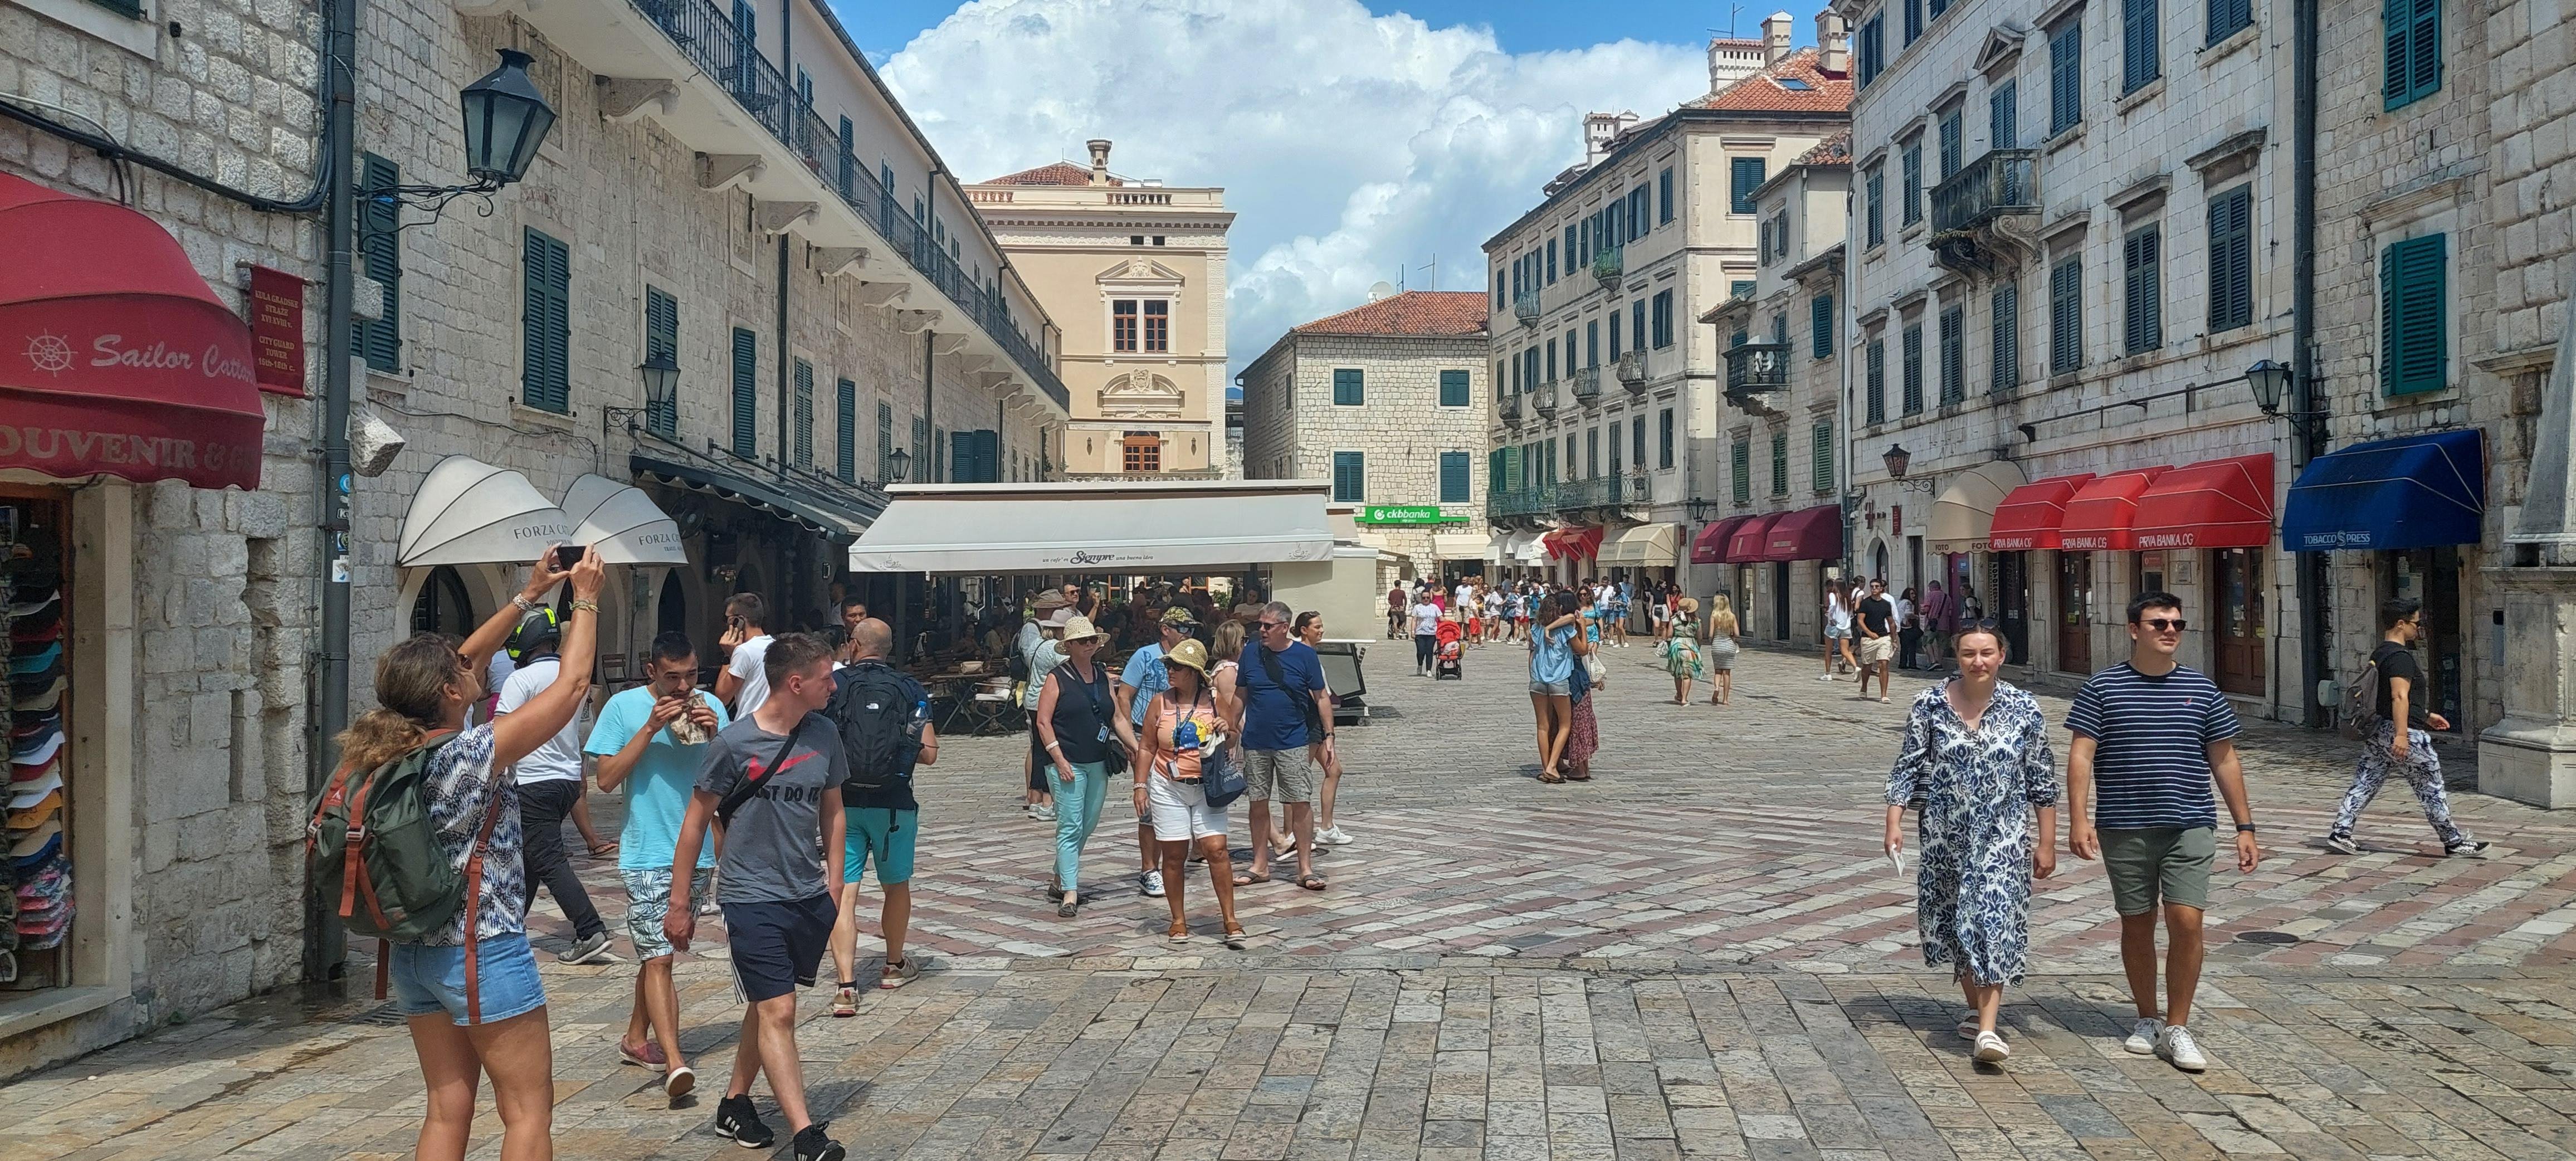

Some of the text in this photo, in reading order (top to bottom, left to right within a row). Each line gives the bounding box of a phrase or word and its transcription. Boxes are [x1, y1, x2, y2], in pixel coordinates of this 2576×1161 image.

[255, 290, 299, 308] KULA GRADSKE
[259, 336, 295, 350] CITY GUARD
[91, 334, 192, 369] Sailor
[266, 348, 287, 359] TOWER
[0, 425, 196, 469] OUVENIR
[1387, 509, 1430, 518] ckbbanka
[514, 524, 555, 539] FORZA
[2304, 534, 2336, 544] TOBACCO
[2346, 533, 2370, 543] PRESS
[638, 534, 671, 545] FORZA
[1994, 537, 2032, 548] PRVA BANKA CG
[2062, 536, 2107, 549] PRVA BANKA CG
[2139, 533, 2193, 548] PRVA BANKA CG
[1070, 550, 1115, 564] Siempre
[755, 786, 780, 801] UST
[784, 787, 803, 802] DO
